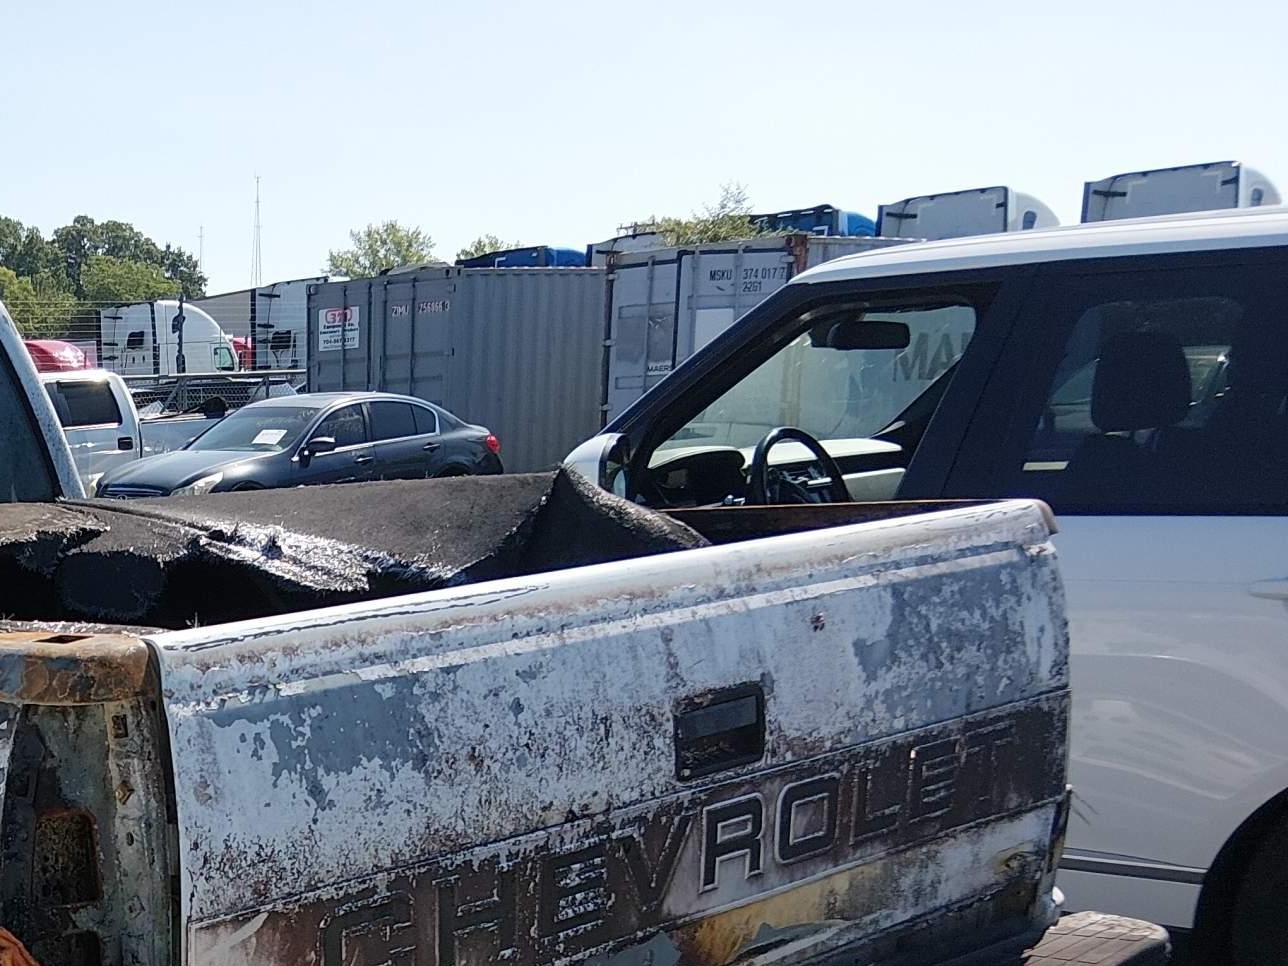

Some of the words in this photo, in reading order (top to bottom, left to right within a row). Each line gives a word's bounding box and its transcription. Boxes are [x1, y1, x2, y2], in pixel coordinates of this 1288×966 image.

[709, 269, 733, 281] MSKU
[742, 268, 758, 280] 374
[761, 267, 777, 279] 017
